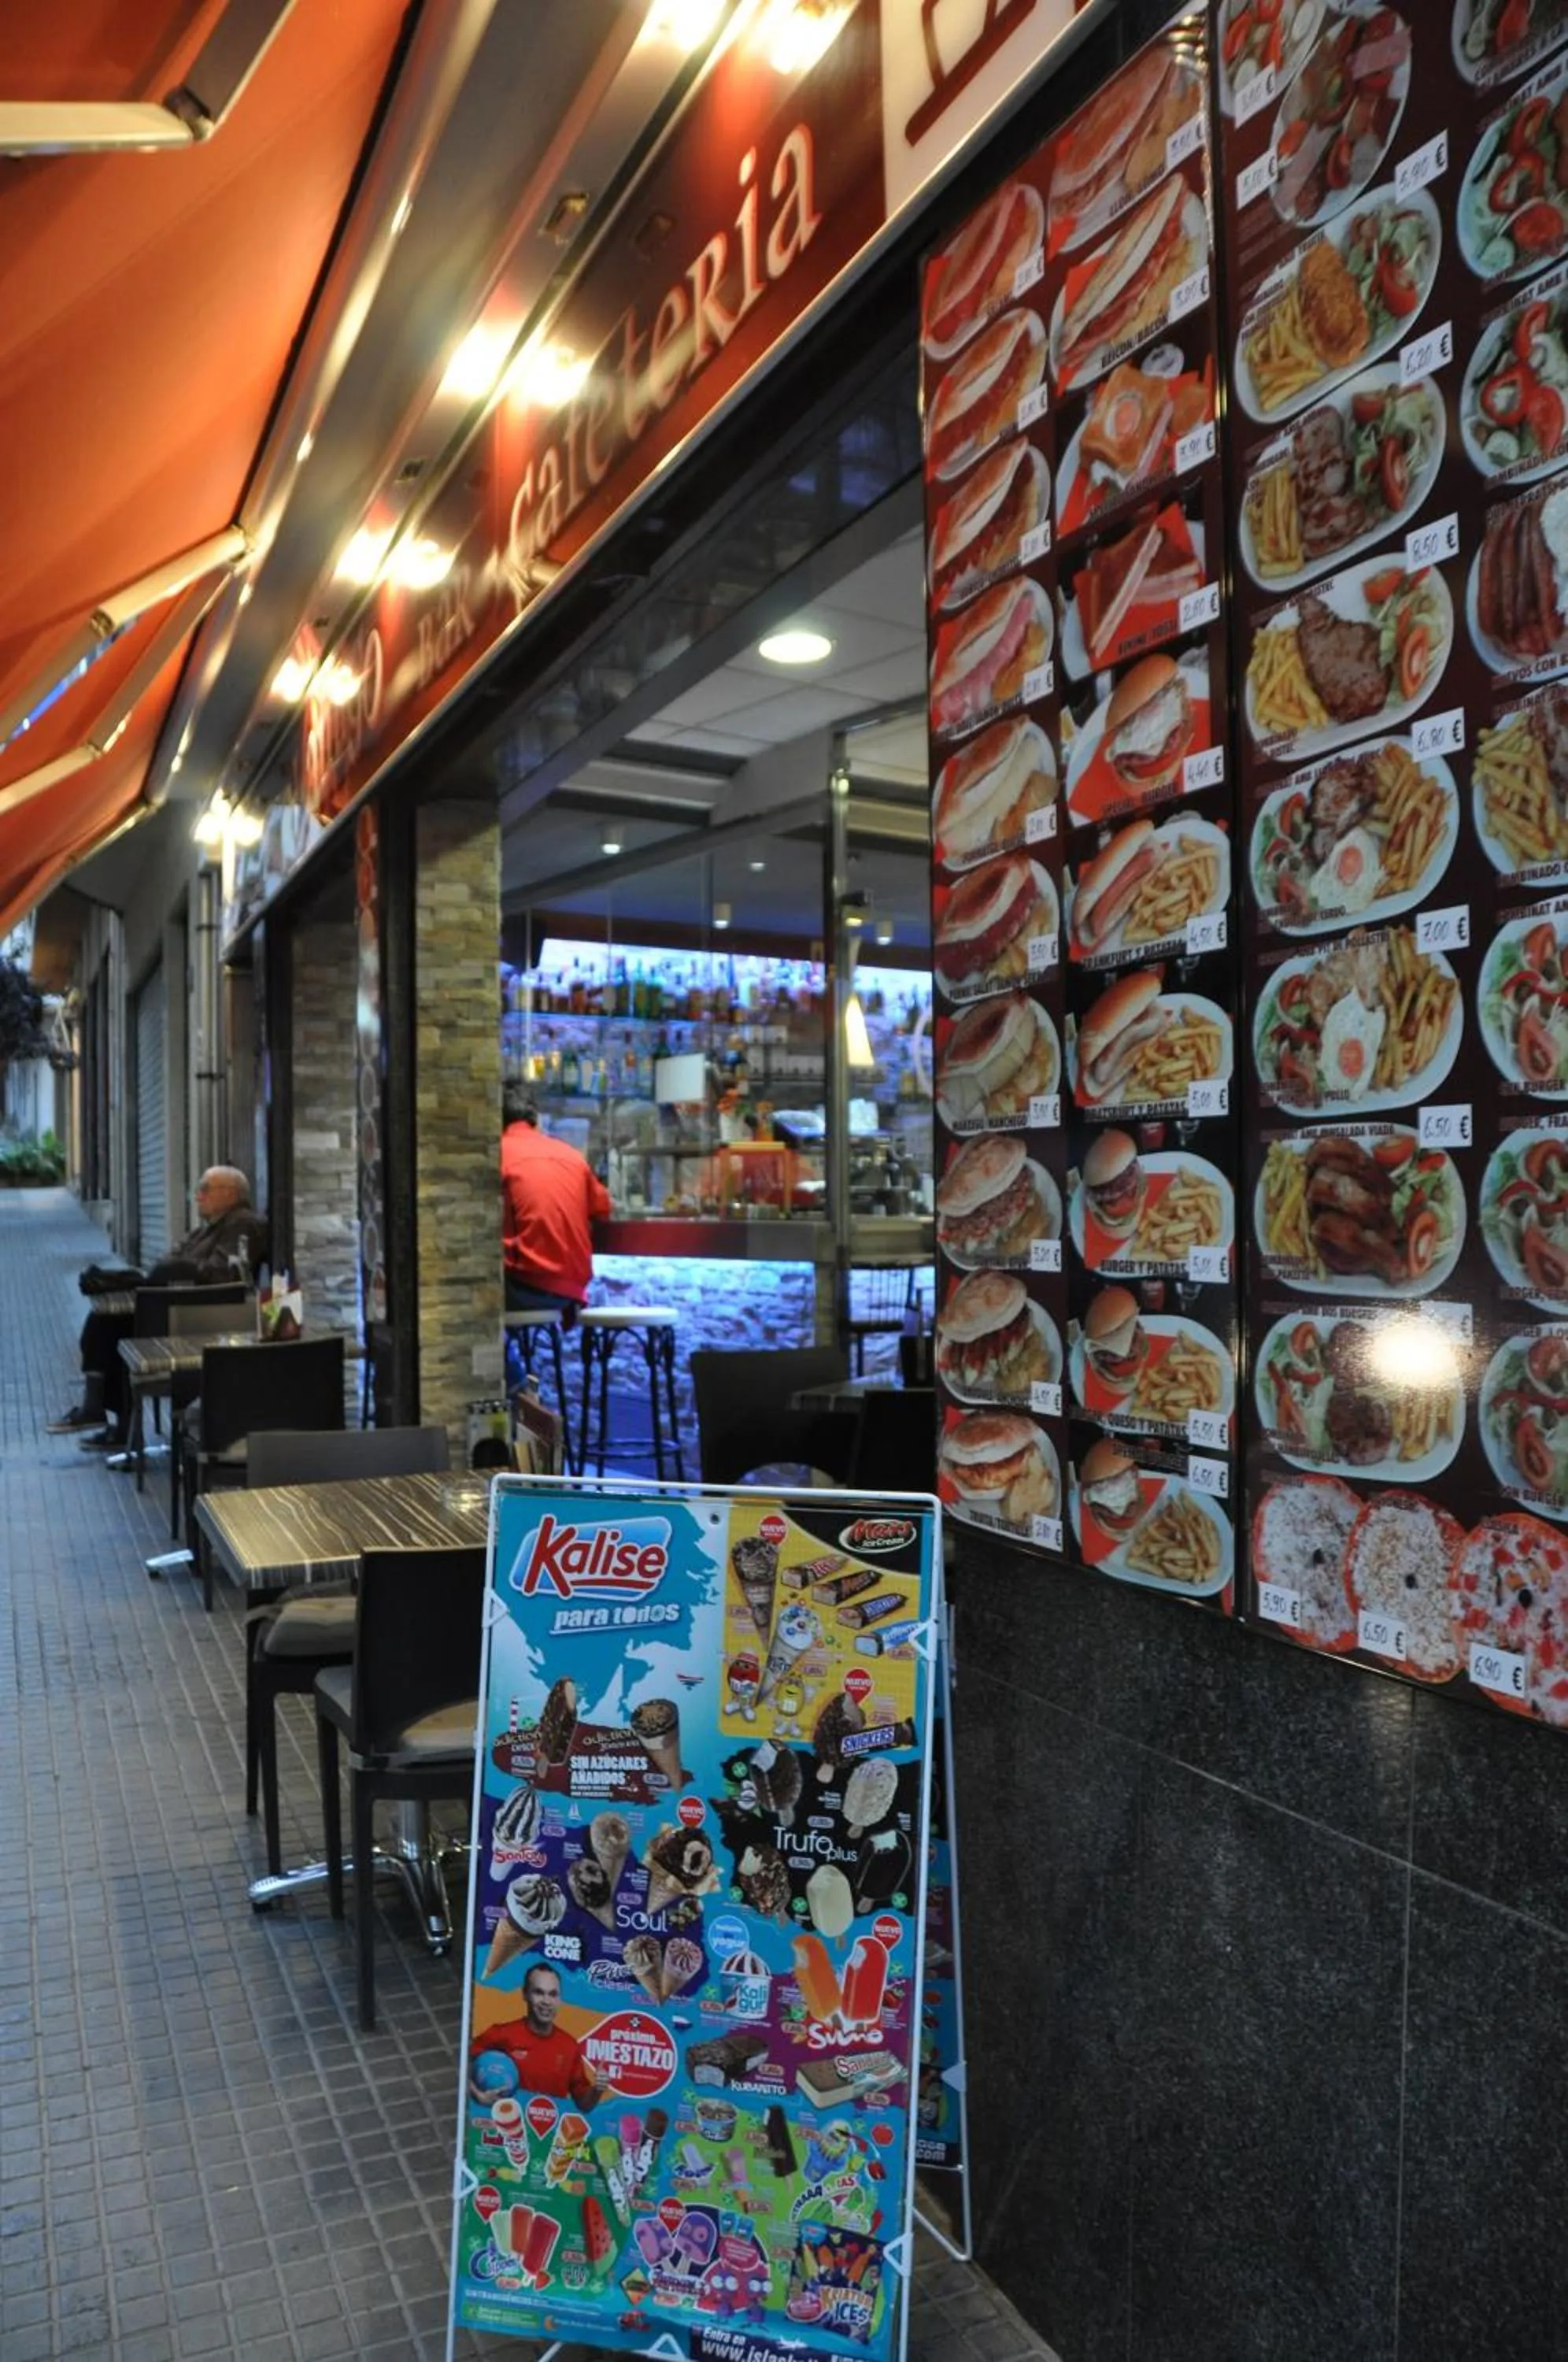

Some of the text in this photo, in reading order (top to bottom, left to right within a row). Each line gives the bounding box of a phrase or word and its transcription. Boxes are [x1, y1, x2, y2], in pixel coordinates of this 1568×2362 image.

[522, 1515, 668, 1598] Kalise
[554, 1603, 681, 1631] para todos
[843, 1727, 895, 1753] SNICKERS
[571, 1769, 626, 1786] AÑADIDOS
[616, 1905, 668, 1933] Soul
[545, 1934, 582, 1949] KING
[544, 1947, 582, 1962] CONE
[586, 2038, 675, 2071] INIESTAZO
[834, 2301, 870, 2323] ICES
[703, 2328, 747, 2345] Entra en
